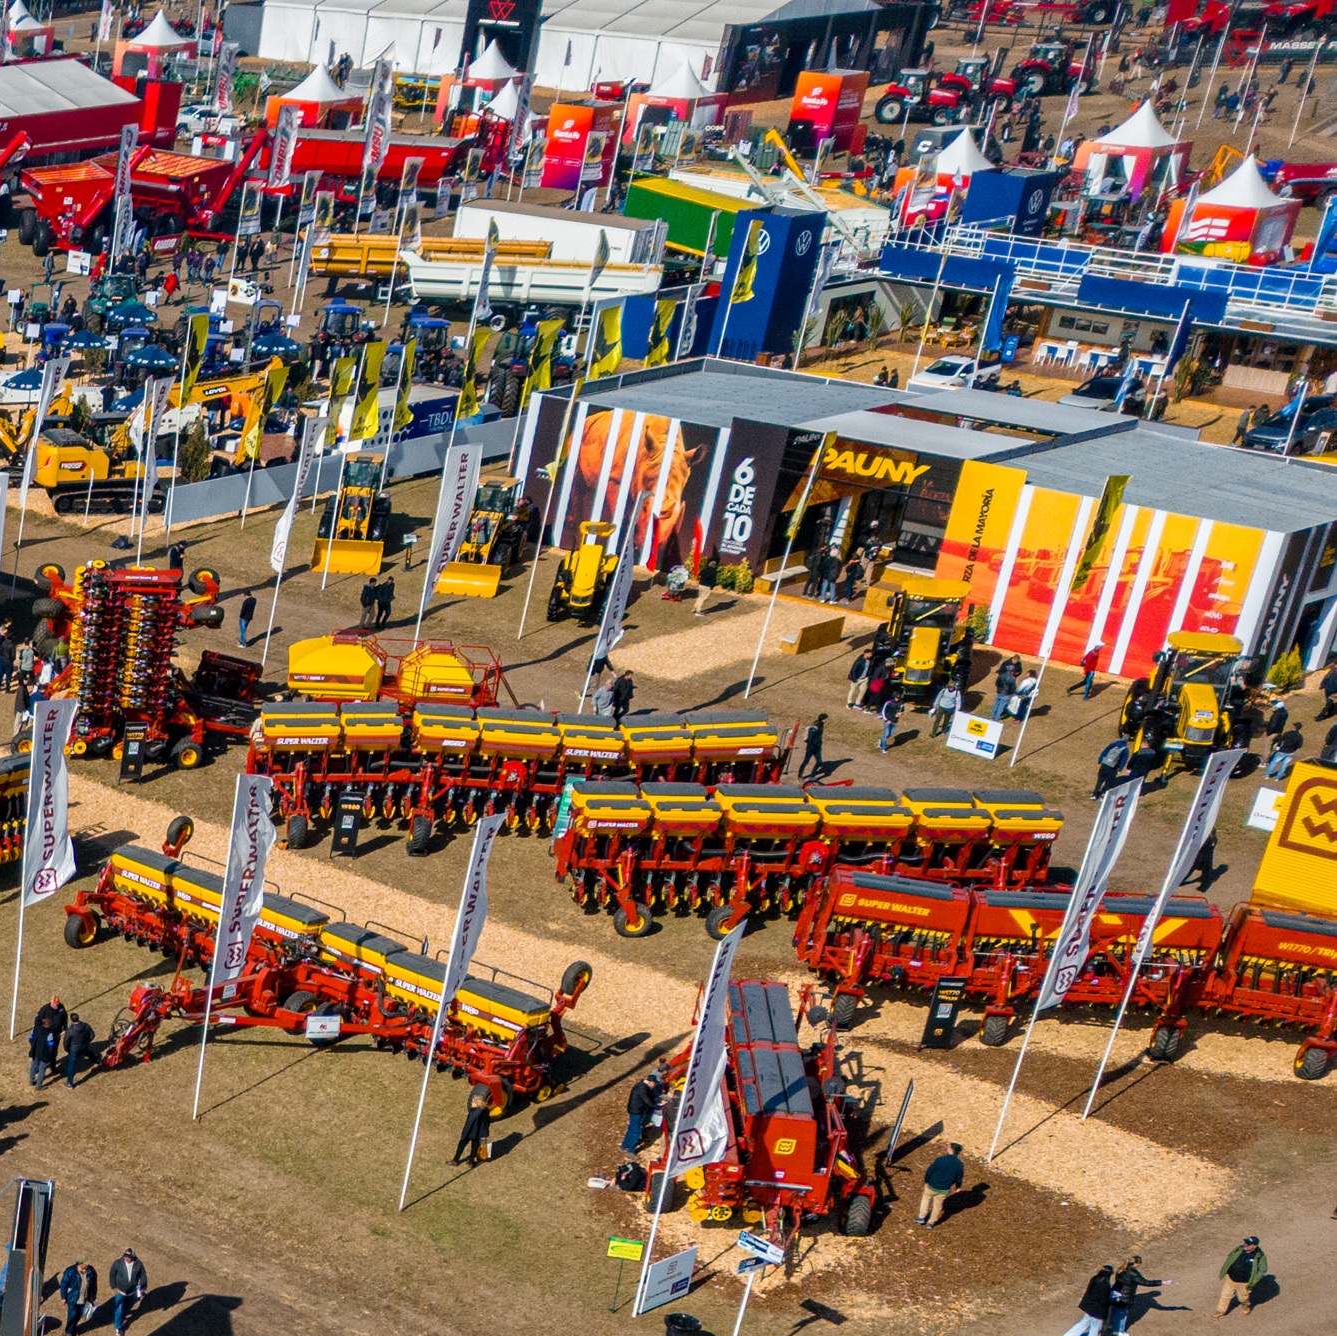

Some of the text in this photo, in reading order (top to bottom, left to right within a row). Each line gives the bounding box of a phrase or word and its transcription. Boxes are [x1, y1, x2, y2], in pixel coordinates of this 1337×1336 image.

[802, 96, 819, 105] Santa
[554, 130, 571, 140] Santa
[273, 137, 288, 180] OMBU
[204, 386, 229, 396] LOVOL
[734, 457, 755, 486] 6
[729, 484, 756, 506] DE
[727, 503, 752, 513] CADA
[976, 488, 995, 532] MAYORÍA
[722, 512, 753, 542] 10
[1260, 573, 1290, 655] PAUNY
[276, 737, 329, 745] SUPER WALTER
[564, 749, 619, 759] SUPER WALTER
[121, 870, 161, 890] SUPER WALTER
[857, 897, 931, 917] SUPER WALTER
[257, 919, 298, 939] SUPER WALTER
[395, 979, 415, 992] SUPER
